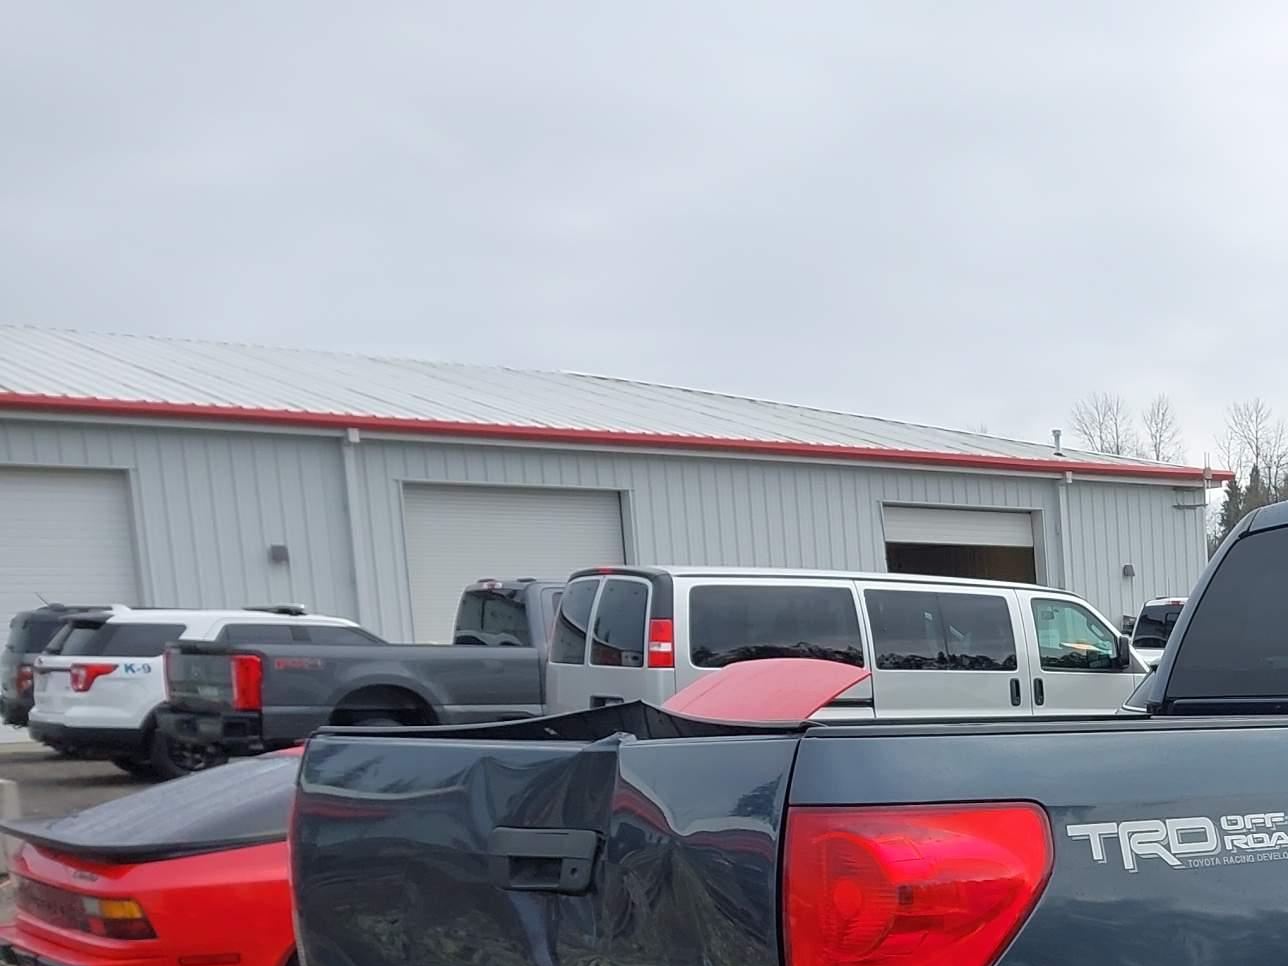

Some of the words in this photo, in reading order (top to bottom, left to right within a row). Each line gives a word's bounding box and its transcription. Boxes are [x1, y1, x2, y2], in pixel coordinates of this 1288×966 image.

[123, 662, 152, 674] K-9
[1220, 811, 1288, 833] OFF
[1066, 816, 1221, 873] TRD
[1187, 857, 1222, 869] TOYOTA
[1223, 854, 1256, 865] RACING
